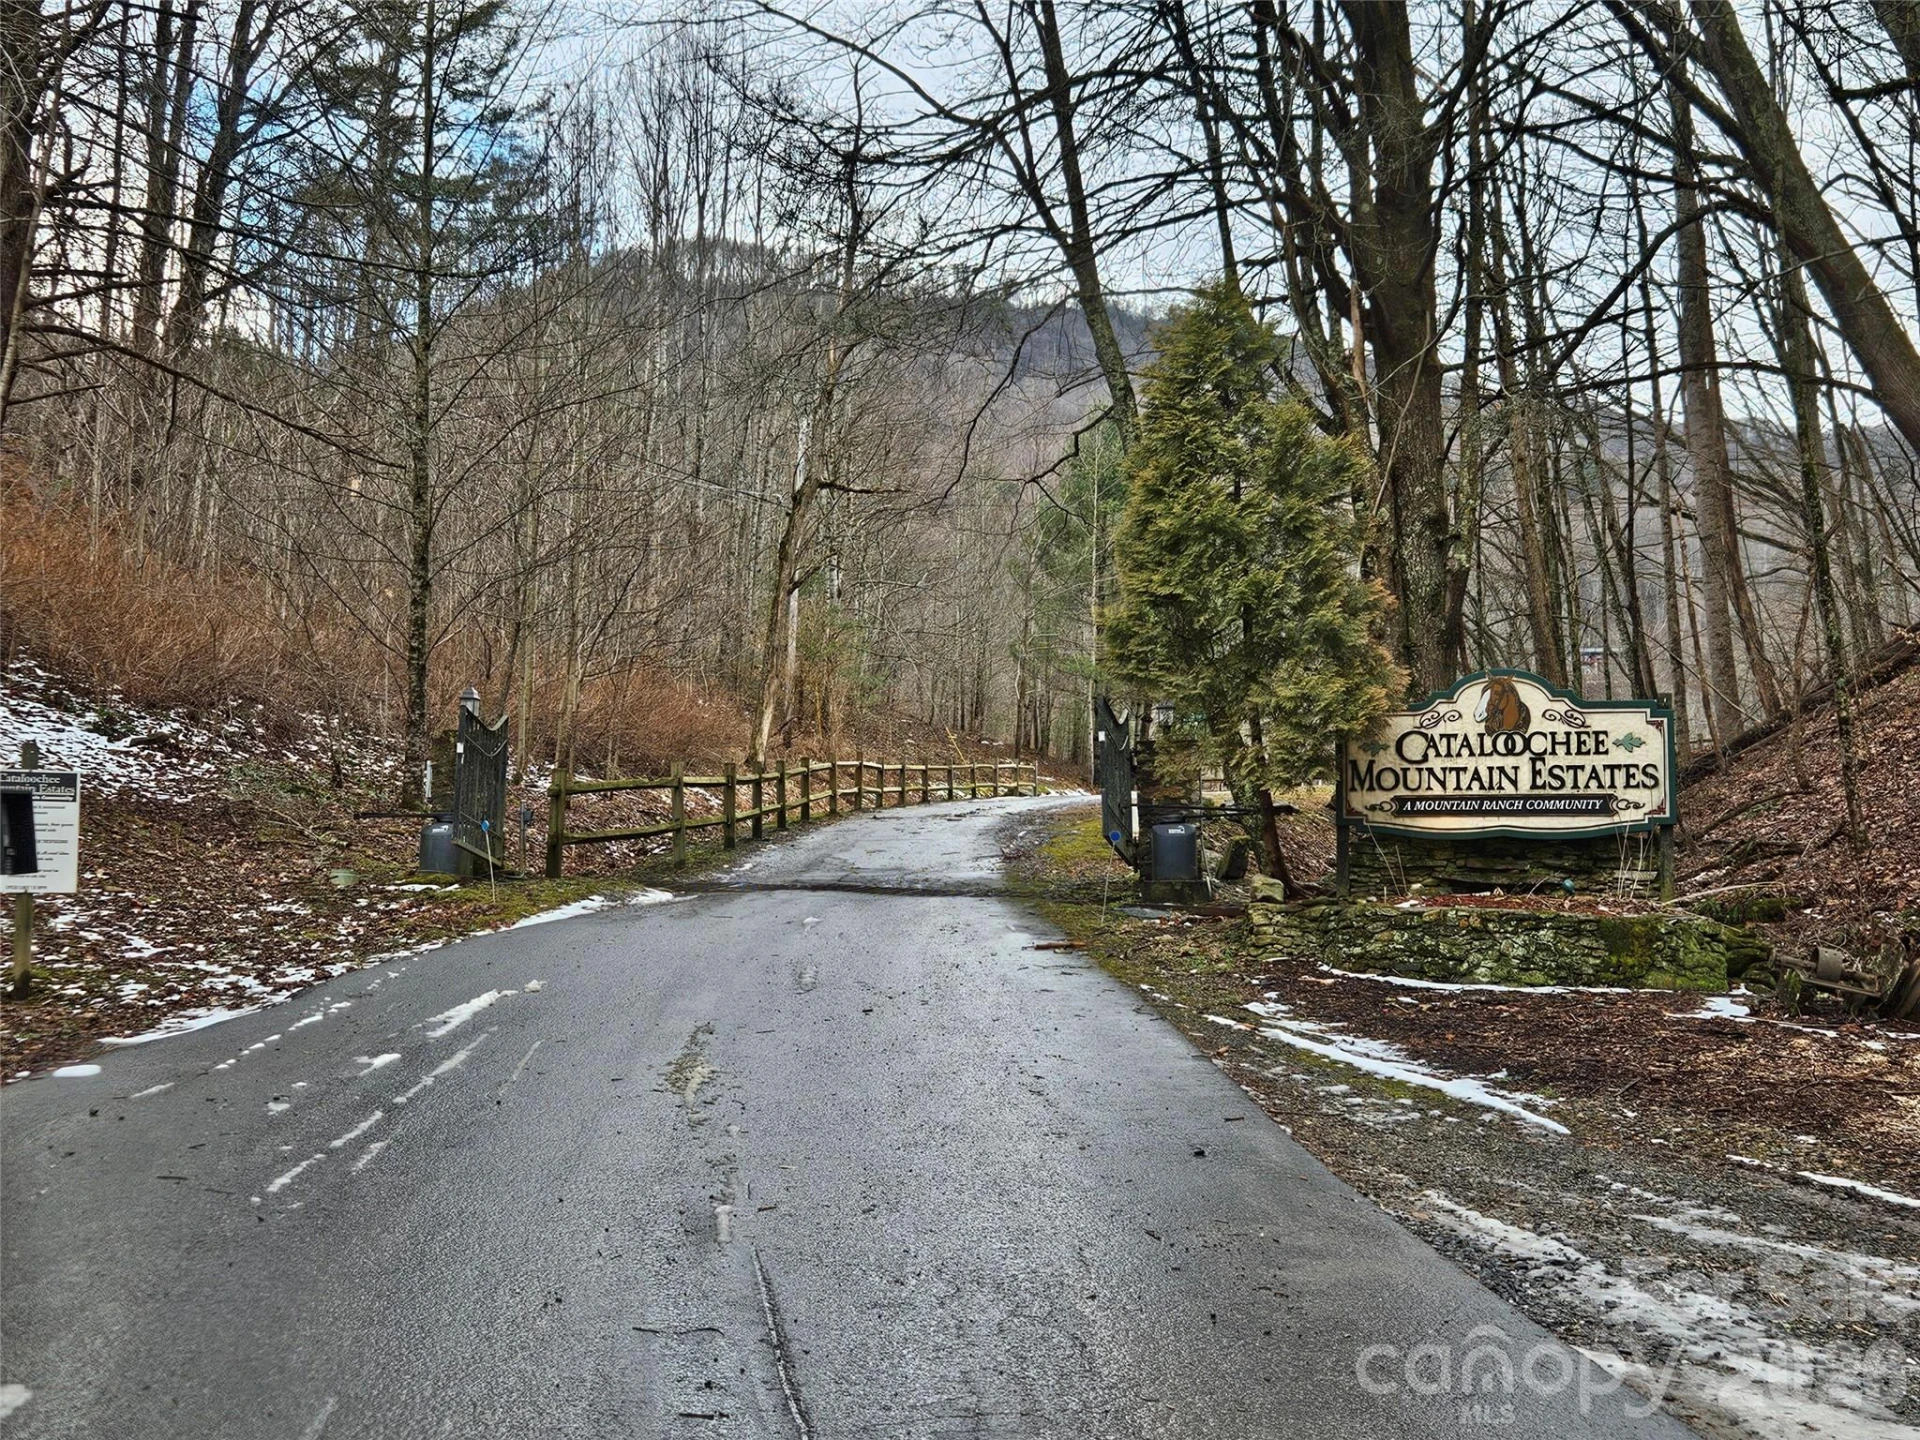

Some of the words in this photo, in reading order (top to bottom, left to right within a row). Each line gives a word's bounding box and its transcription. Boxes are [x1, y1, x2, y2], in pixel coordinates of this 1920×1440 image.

[1395, 730, 1609, 765] CATALOOCHEE
[1348, 759, 1520, 793] MOUNTAIN
[1528, 756, 1659, 791] ESTATES
[1403, 800, 1411, 811] A
[1413, 800, 1479, 811] MOUNTAIN
[1481, 800, 1523, 811] RANCH
[1525, 799, 1604, 811] COMMUNITY
